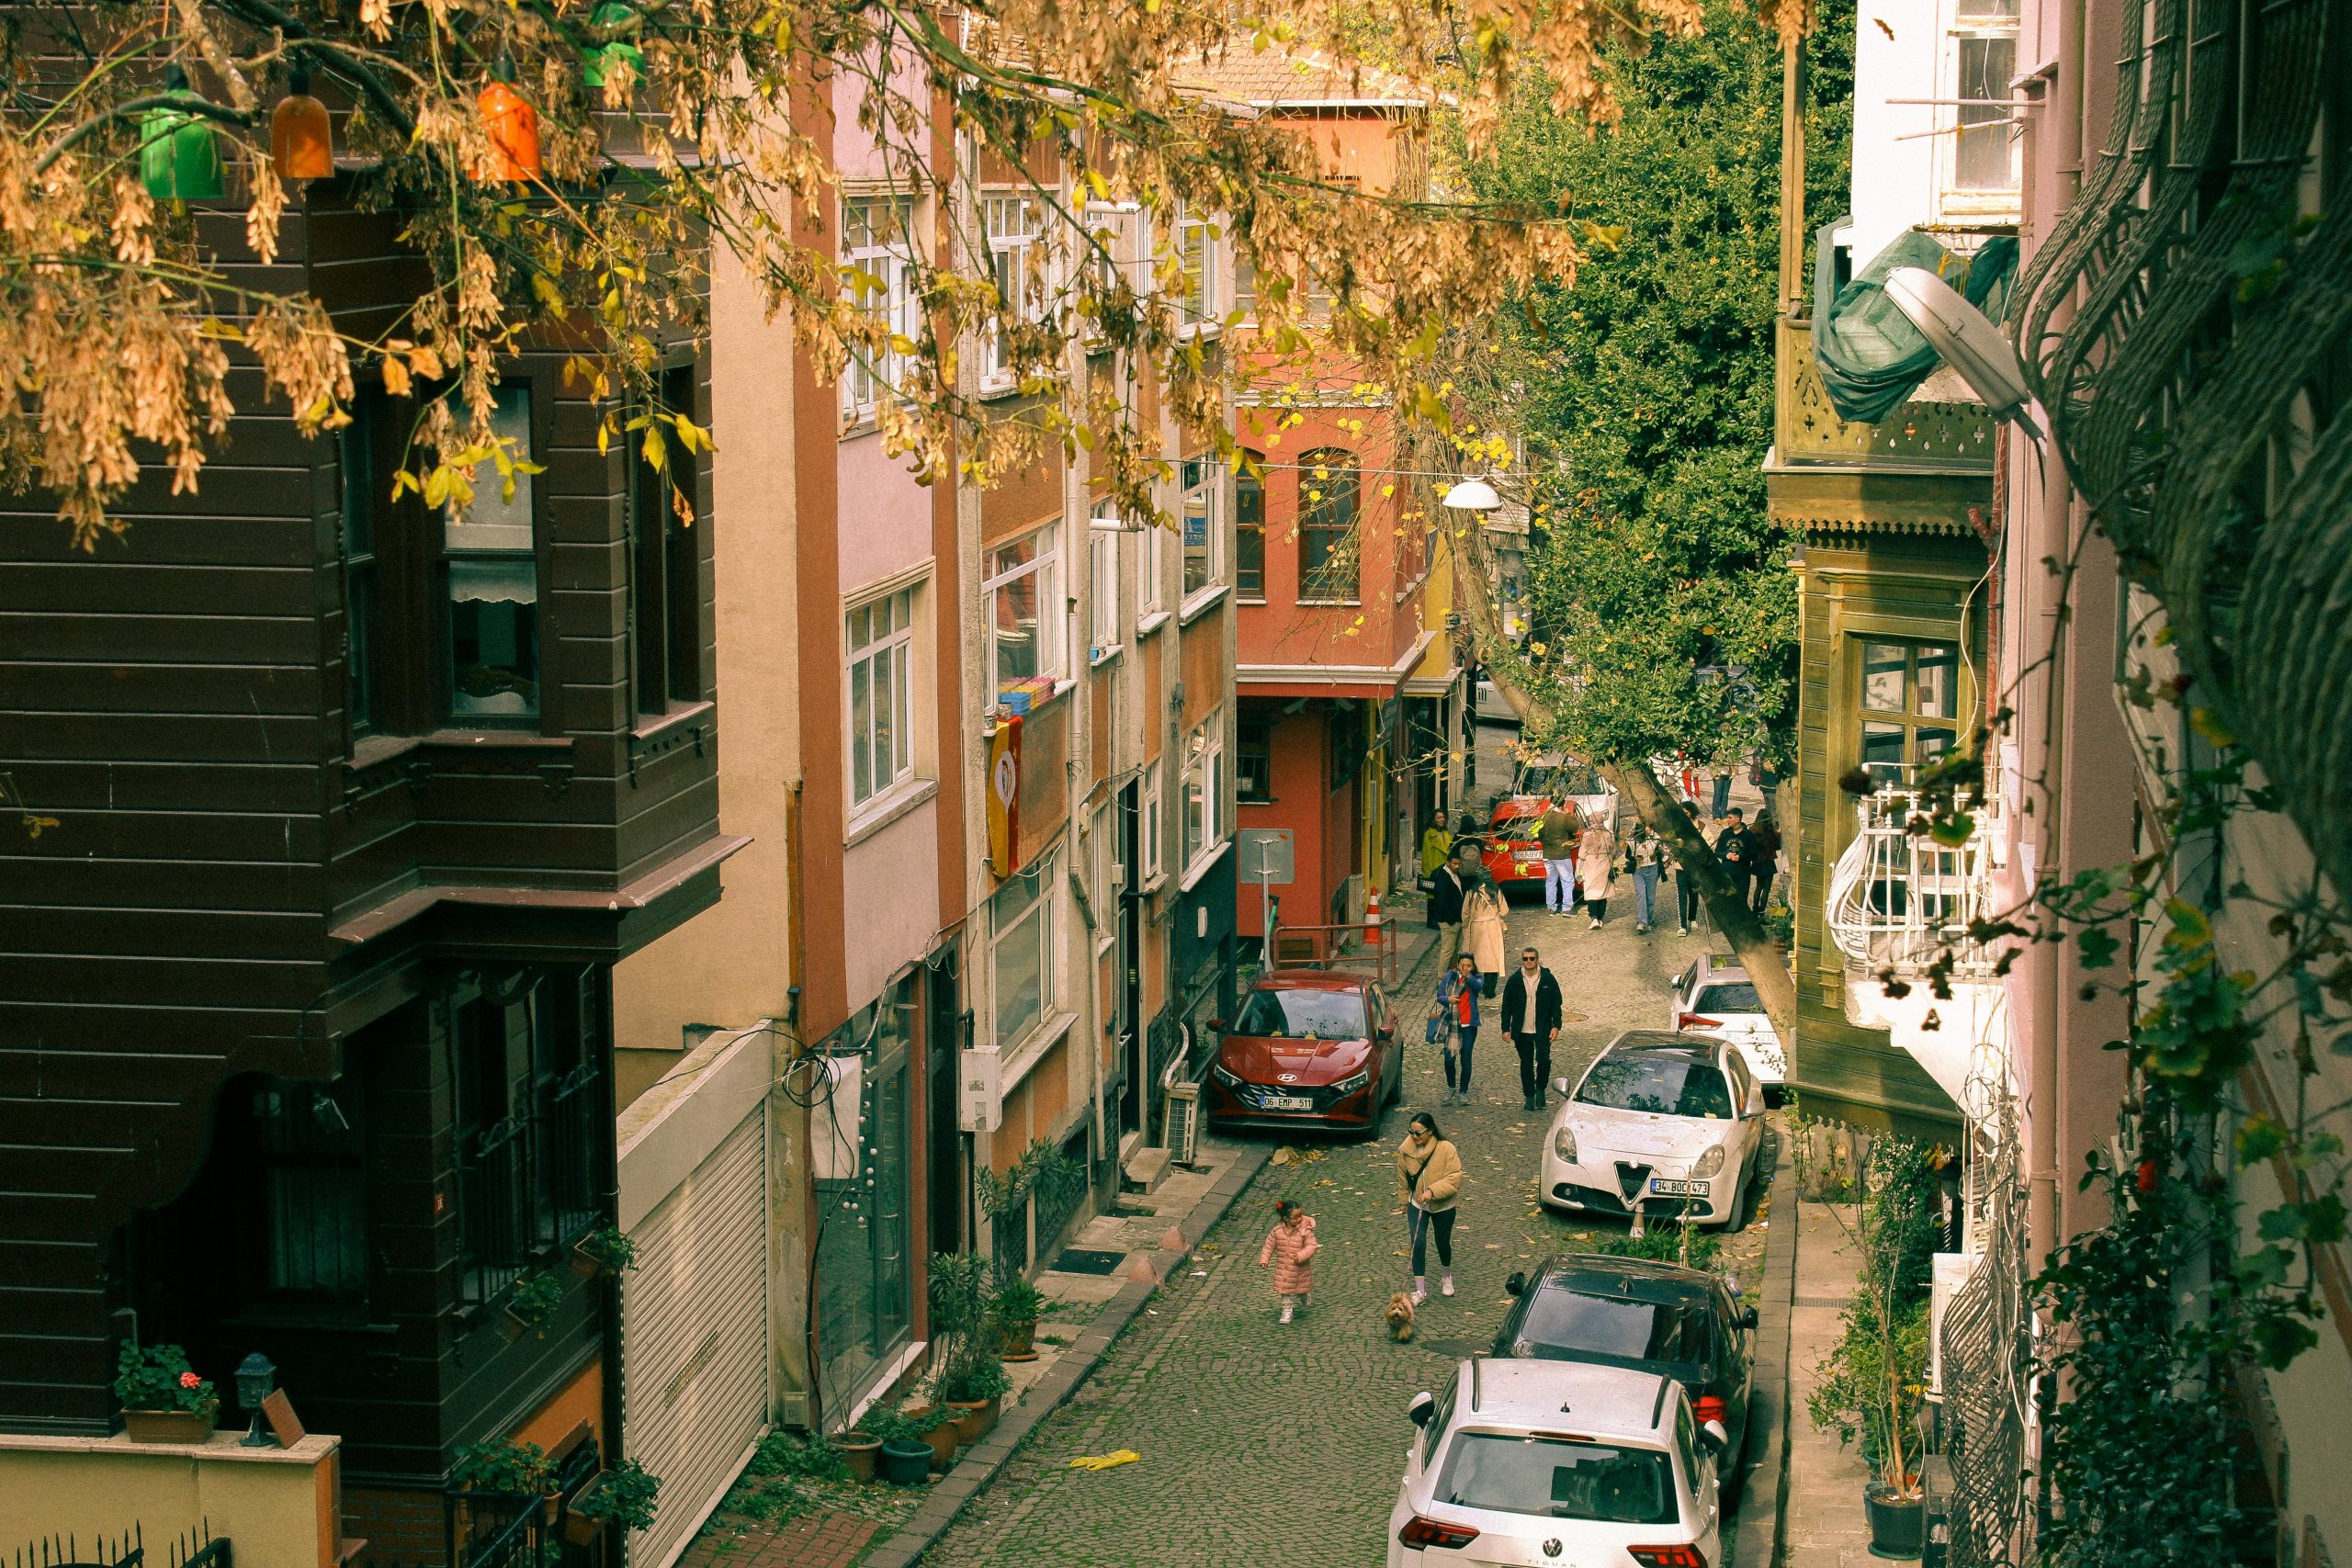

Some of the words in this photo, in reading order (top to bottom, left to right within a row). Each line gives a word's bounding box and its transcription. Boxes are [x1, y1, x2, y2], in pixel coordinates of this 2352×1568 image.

[1264, 1097, 1274, 1106] 06
[1278, 1098, 1293, 1107] EMP
[1299, 1099, 1311, 1108] 511
[1657, 1181, 1667, 1190] 34
[1691, 1183, 1707, 1193] 473
[1527, 1559, 1577, 1568] TIGUAN
